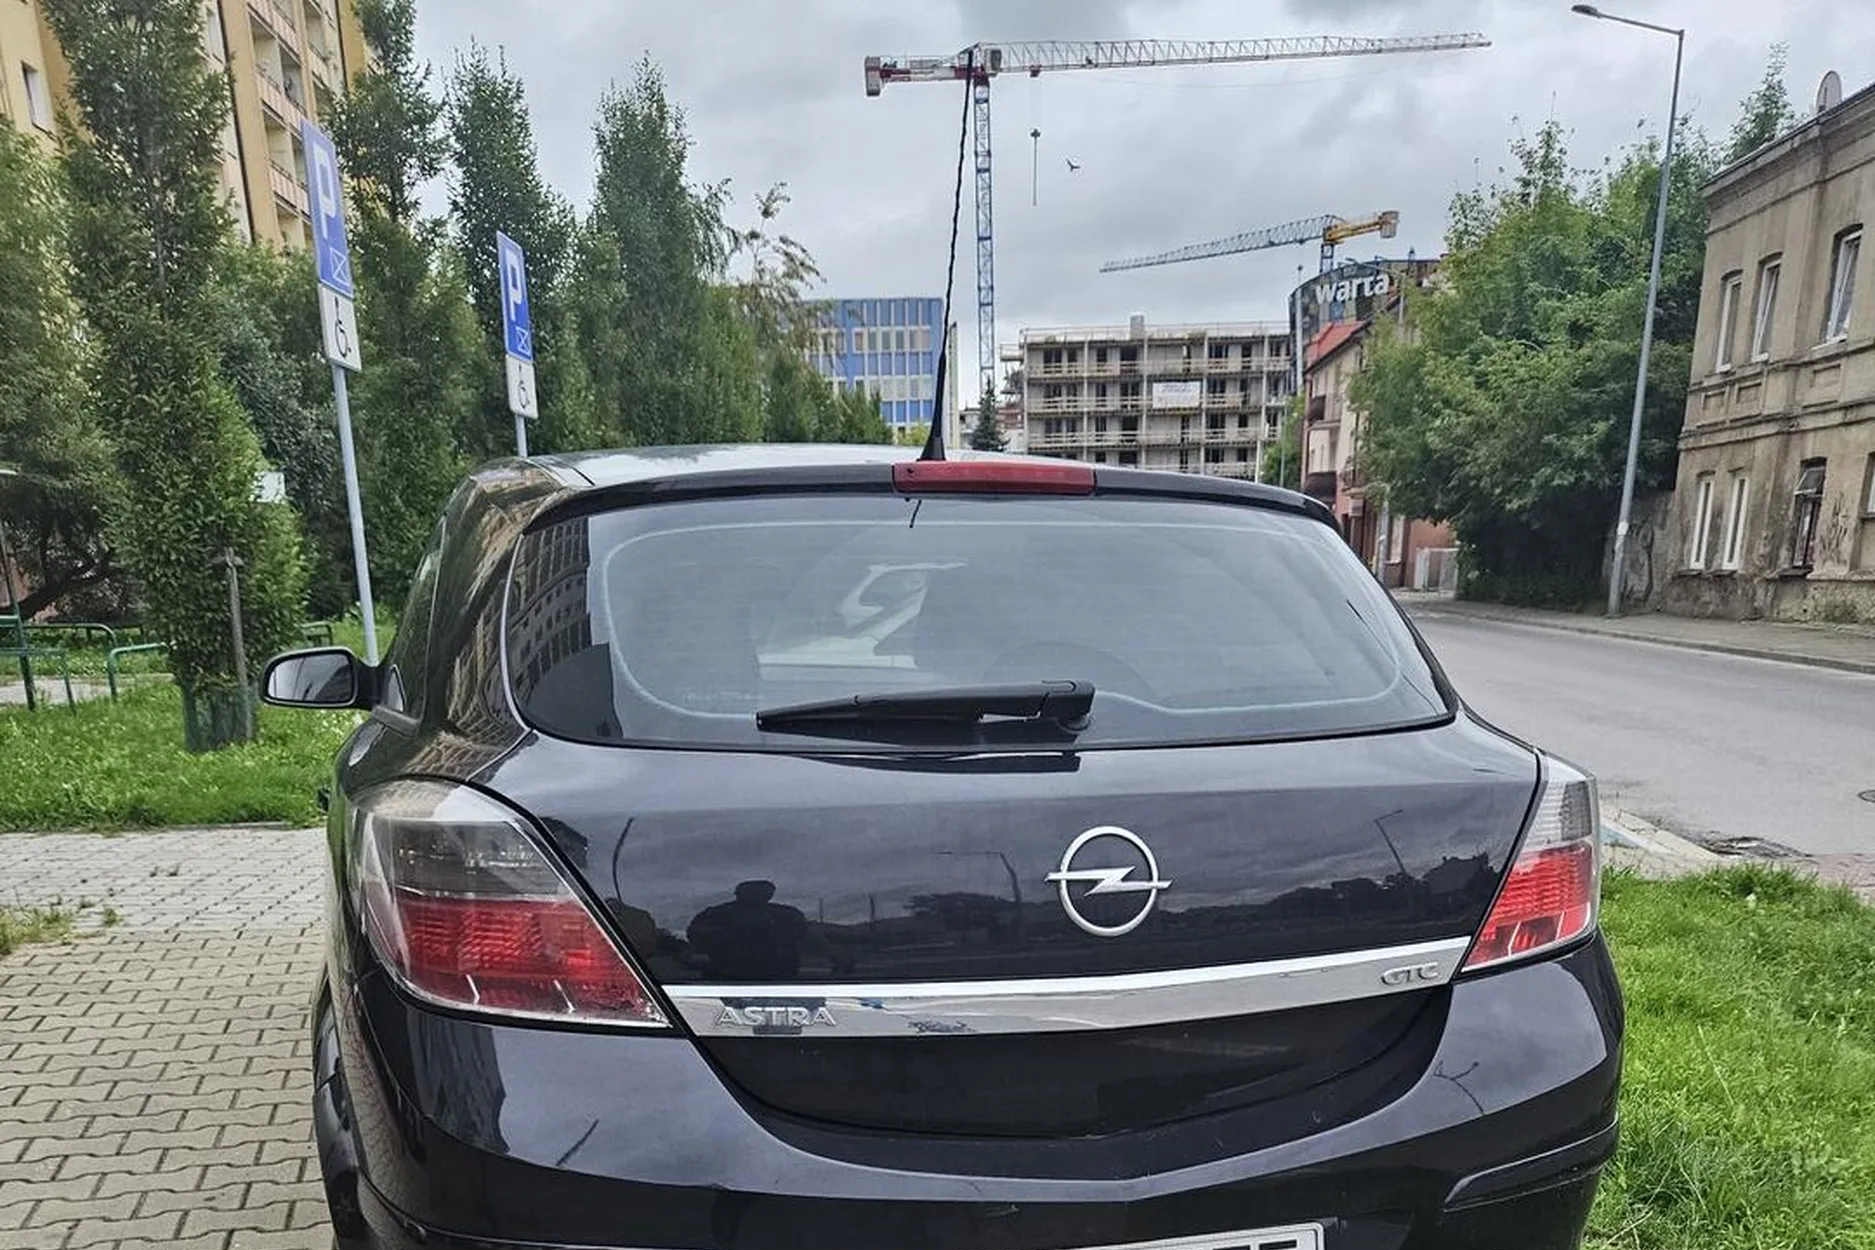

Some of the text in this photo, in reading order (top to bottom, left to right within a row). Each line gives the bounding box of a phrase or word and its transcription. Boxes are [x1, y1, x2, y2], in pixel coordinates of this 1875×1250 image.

[313, 142, 336, 239] P
[505, 248, 522, 321] P
[1316, 273, 1390, 303] warta
[1380, 962, 1439, 985] GTC
[715, 1006, 837, 1026] ASTRA
